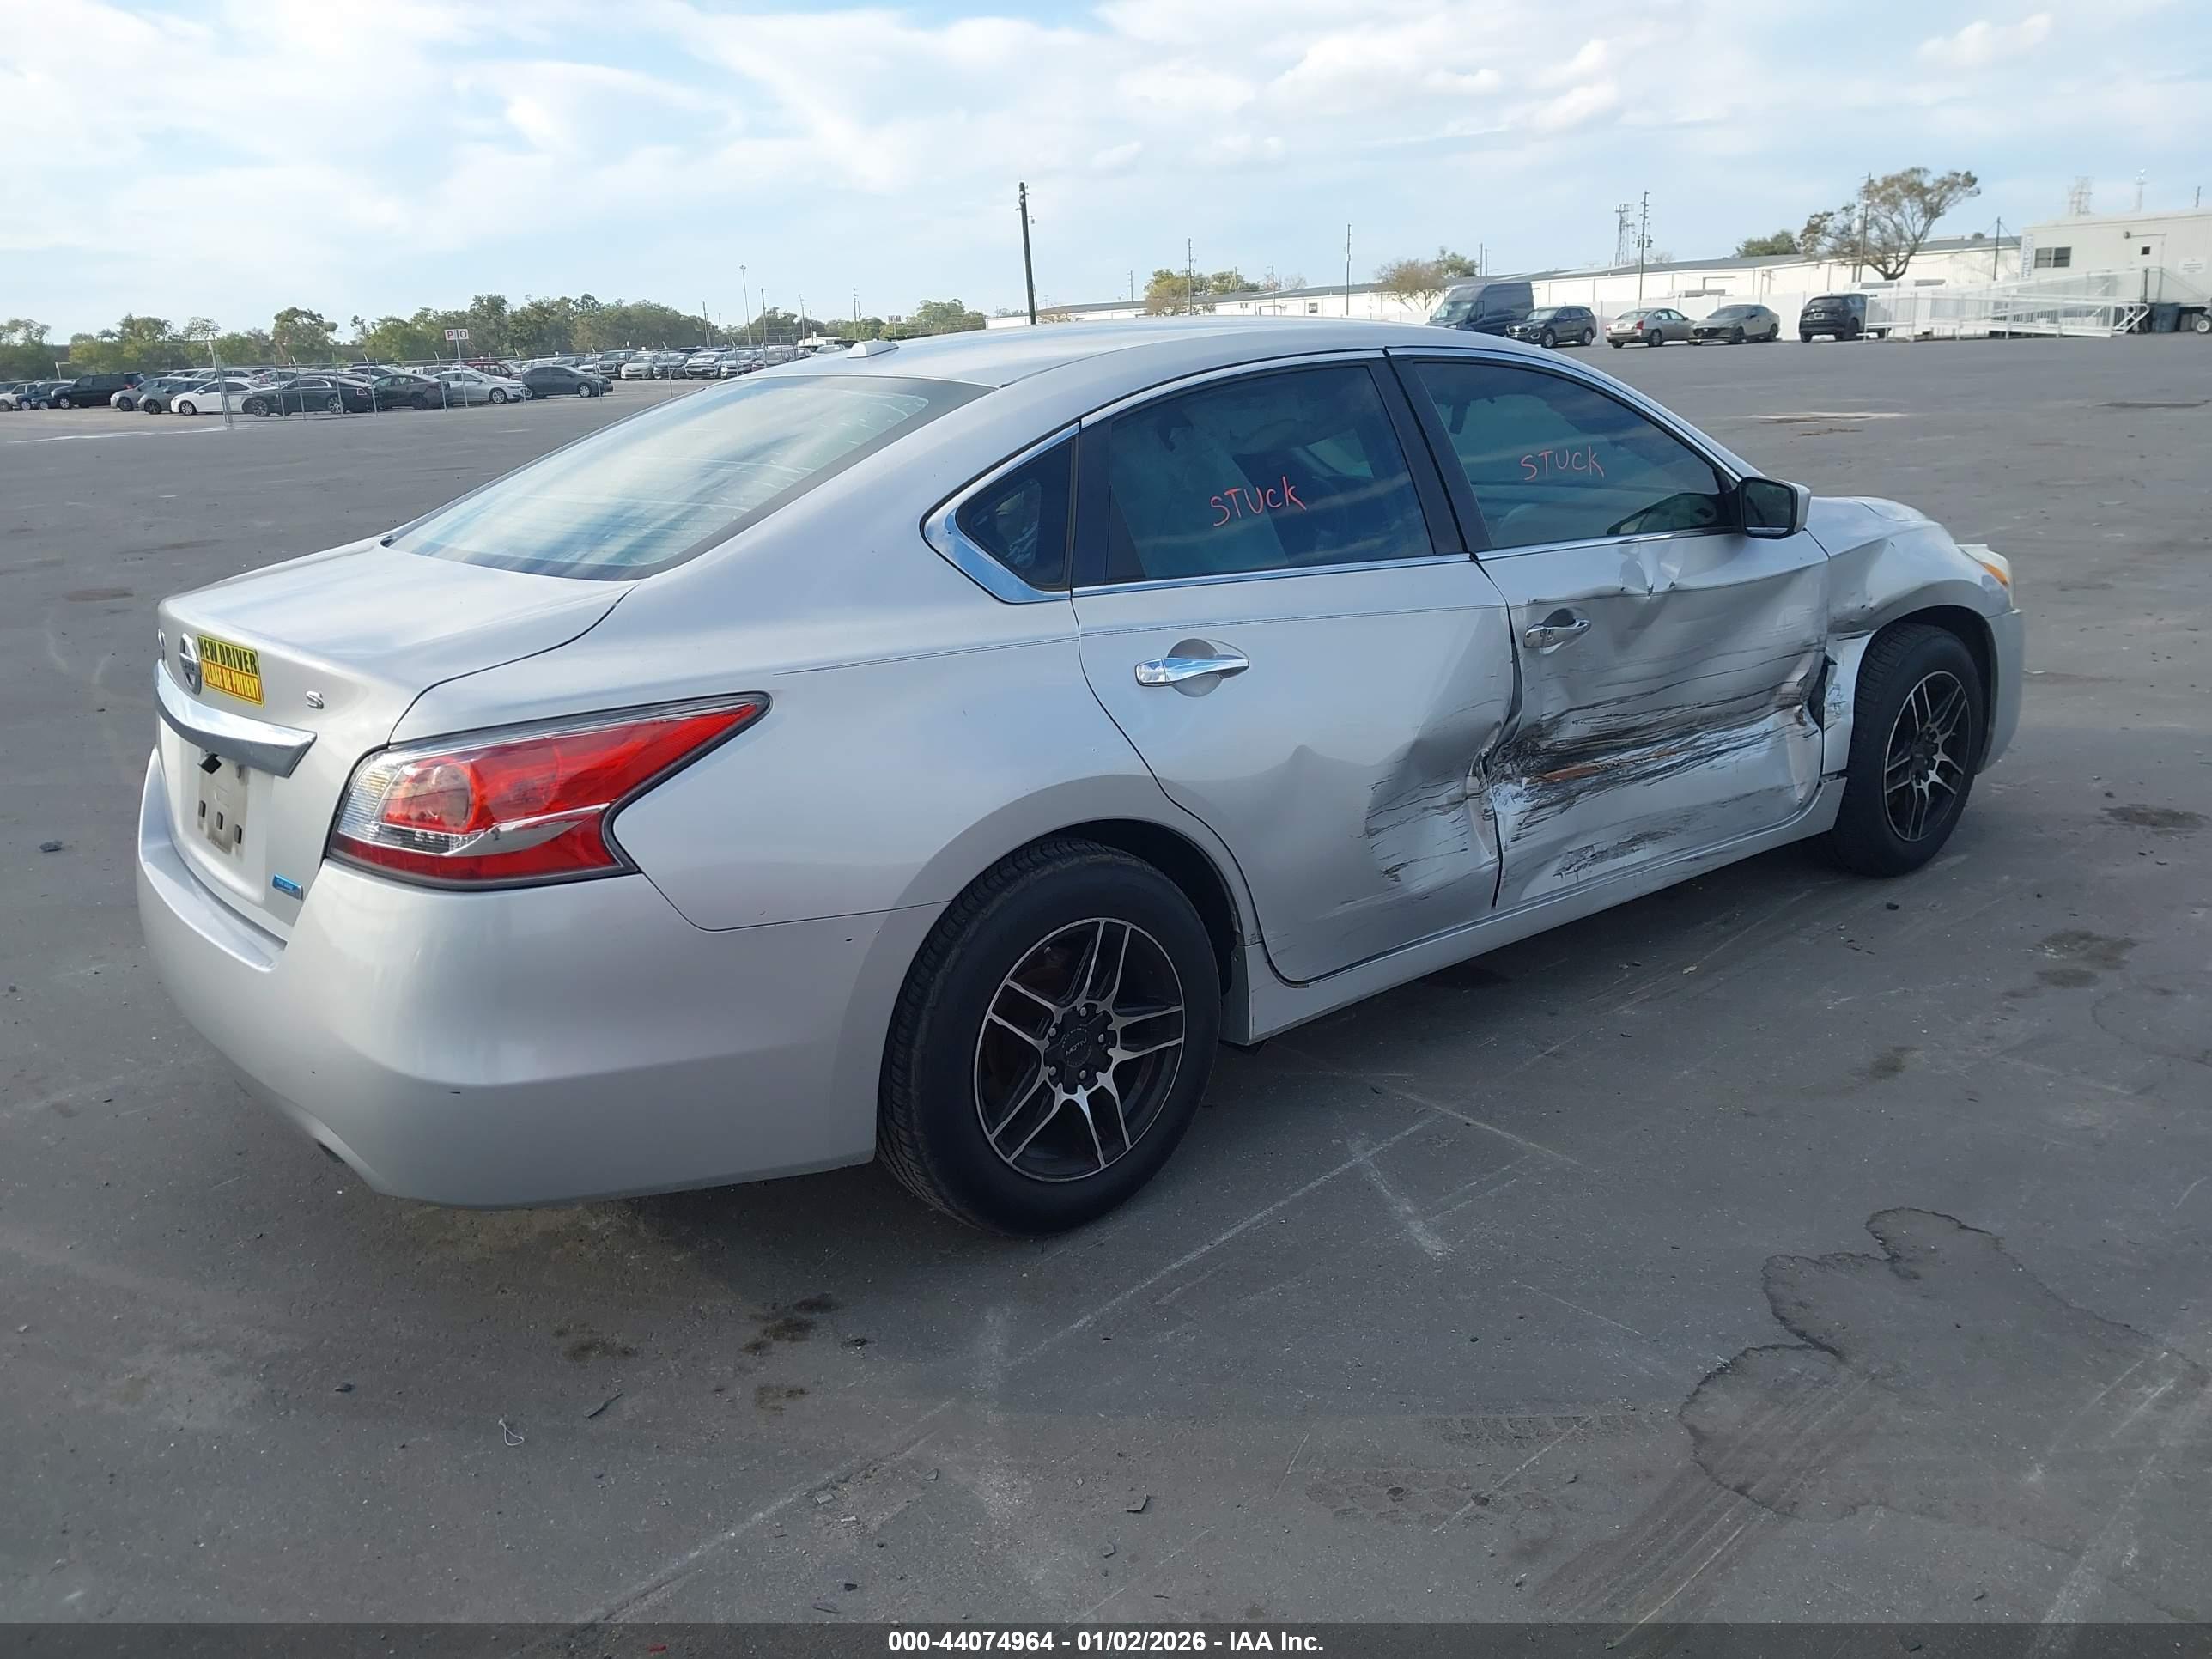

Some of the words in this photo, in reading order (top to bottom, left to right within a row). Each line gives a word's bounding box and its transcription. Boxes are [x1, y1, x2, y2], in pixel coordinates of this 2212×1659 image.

[447, 331, 453, 339] P
[198, 636, 218, 663] NEW
[217, 643, 259, 676] DRIVER
[202, 659, 224, 688] PLEASE
[231, 670, 261, 701] PATIENT
[306, 690, 325, 710] S
